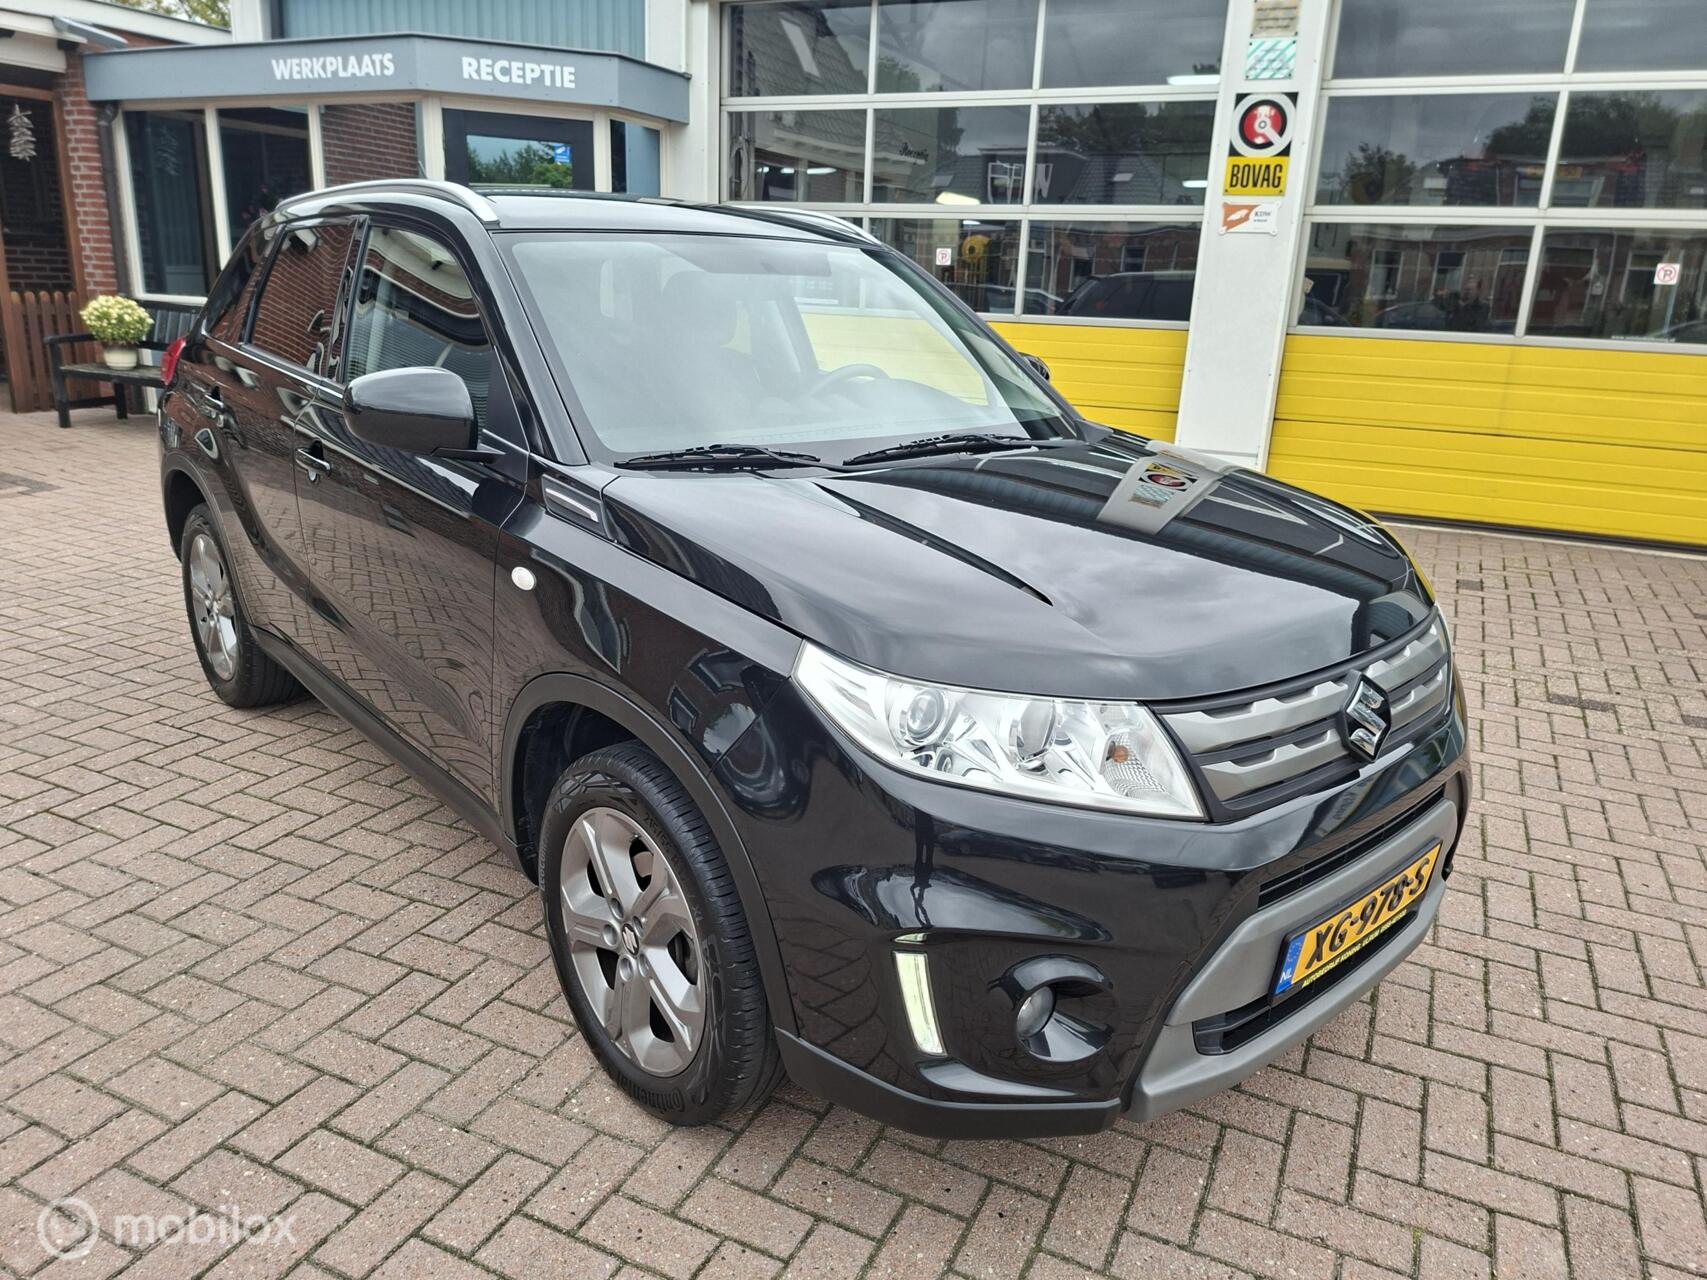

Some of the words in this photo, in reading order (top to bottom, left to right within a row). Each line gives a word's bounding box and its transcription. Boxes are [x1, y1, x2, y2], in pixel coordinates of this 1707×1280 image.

[272, 53, 394, 80] WERKPLAATS
[461, 57, 576, 89] RECEPTIE
[1229, 163, 1283, 189] BOVAG
[1305, 857, 1430, 970] XG-978-S
[1279, 966, 1292, 983] NL
